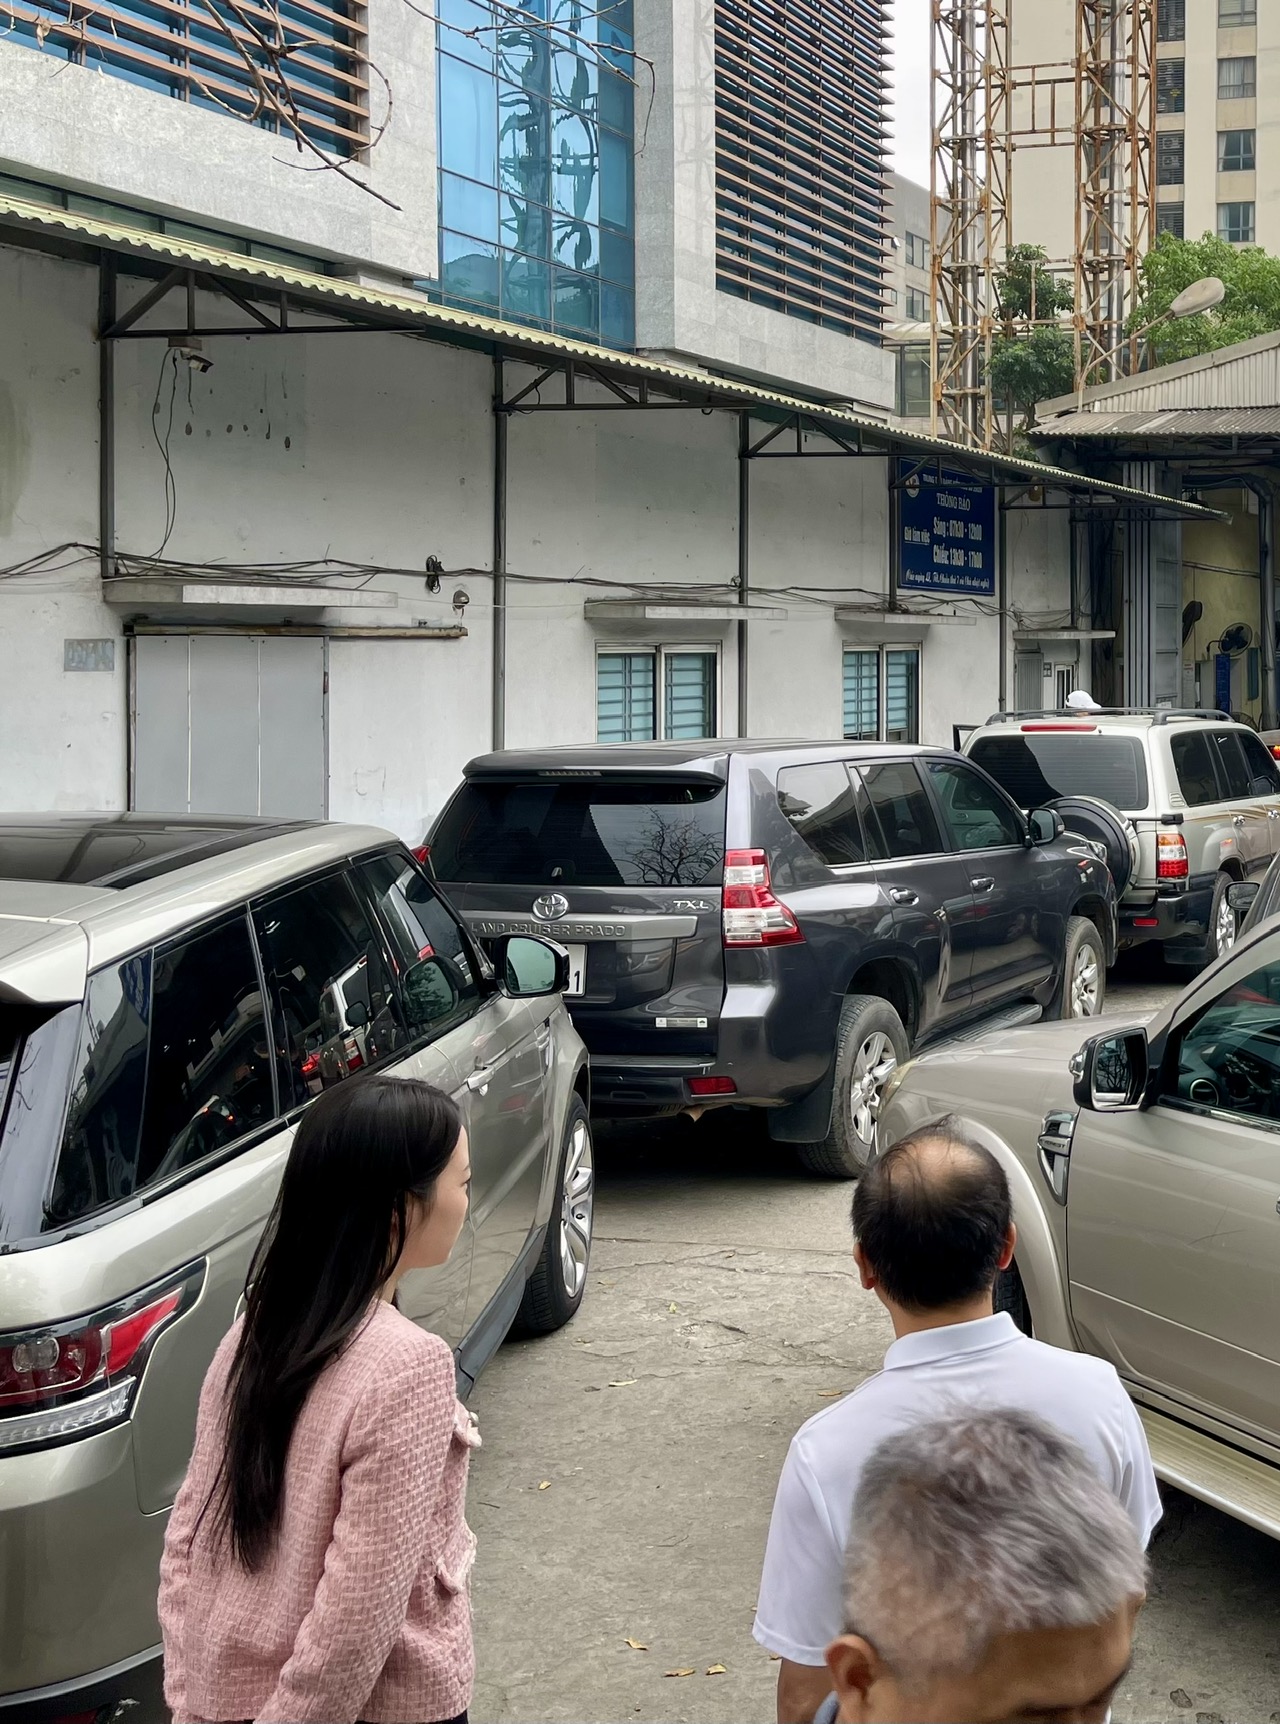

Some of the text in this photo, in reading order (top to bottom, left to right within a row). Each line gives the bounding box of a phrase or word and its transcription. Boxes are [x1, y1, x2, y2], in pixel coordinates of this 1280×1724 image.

[471, 922, 626, 937] LAND CRUISER PRADO
